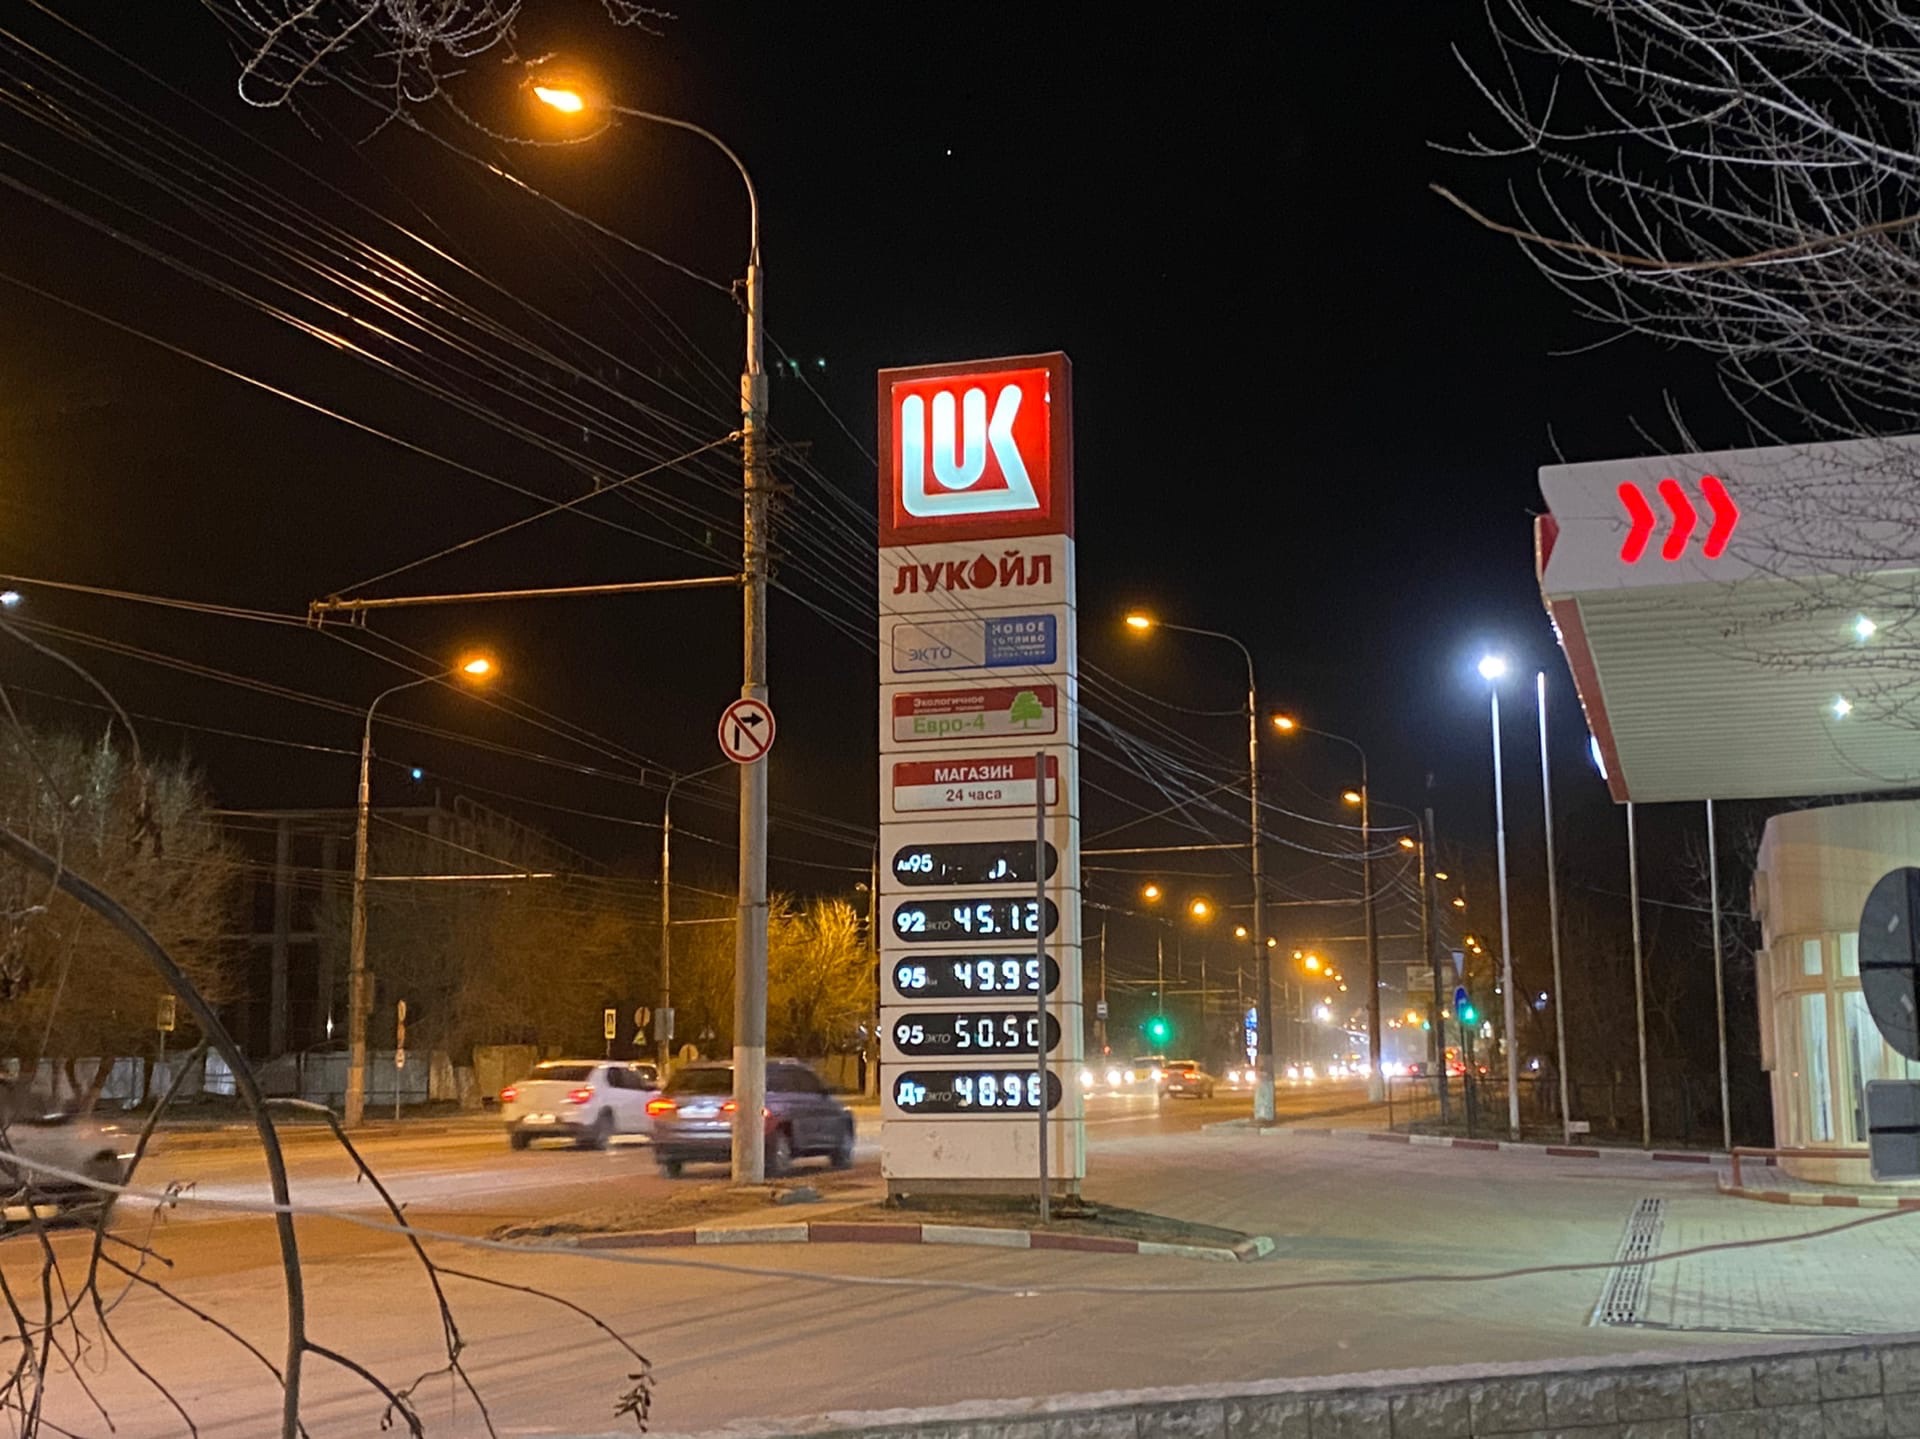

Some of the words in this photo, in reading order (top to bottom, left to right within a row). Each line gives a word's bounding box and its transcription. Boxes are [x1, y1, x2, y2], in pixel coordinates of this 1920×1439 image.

[893, 550, 1053, 595] ЛУКОЙЛ
[908, 646, 952, 661] ЭКТО
[913, 695, 985, 708] Экологичное
[913, 713, 985, 736] Евро-4
[934, 764, 1014, 783] МАГАЗИН
[946, 789, 964, 802] 24
[968, 788, 1002, 801] часа
[897, 911, 926, 933] 92
[898, 966, 926, 989] 95
[897, 1025, 924, 1045] 95
[924, 1033, 951, 1044] ЭКТО
